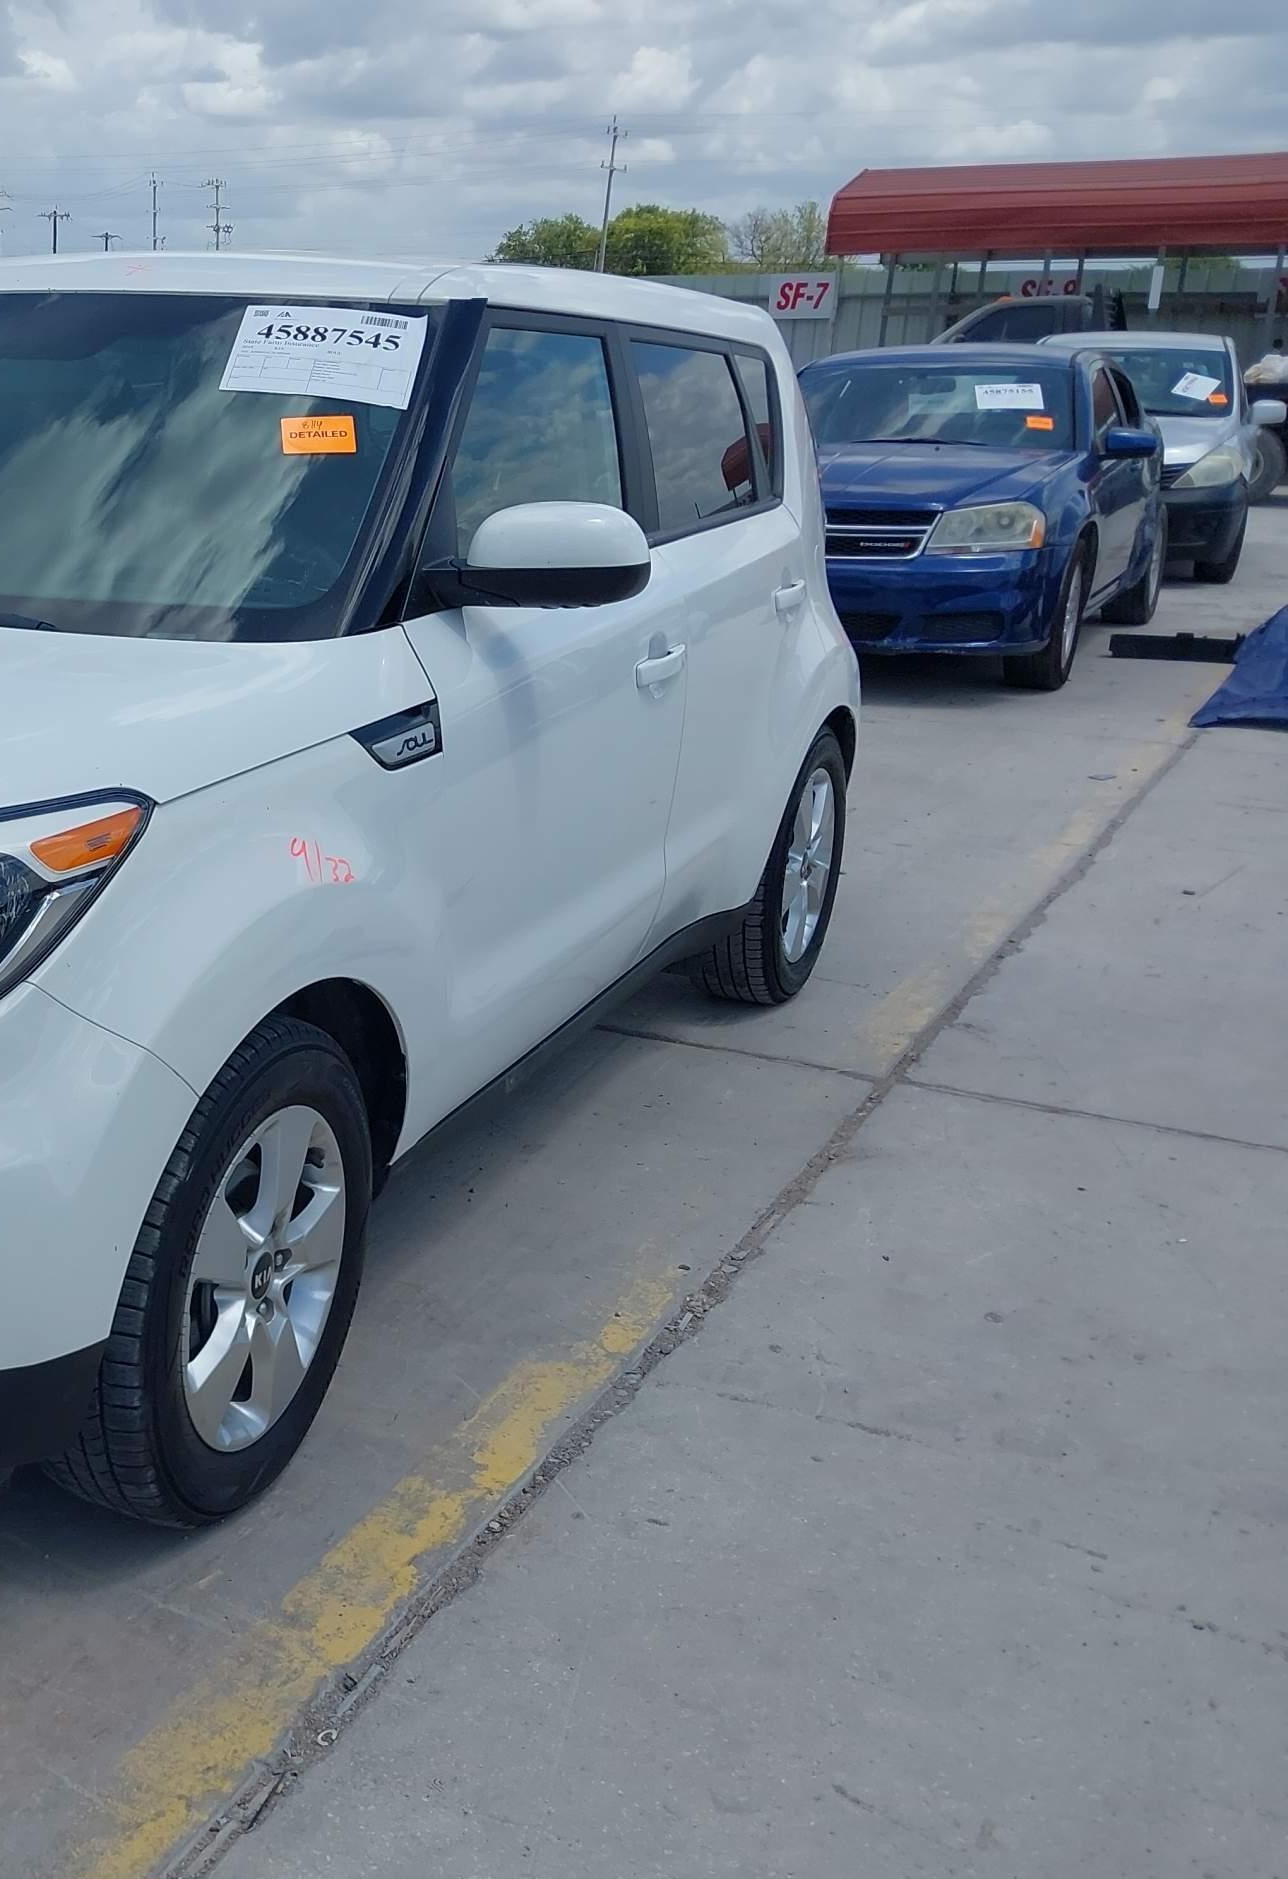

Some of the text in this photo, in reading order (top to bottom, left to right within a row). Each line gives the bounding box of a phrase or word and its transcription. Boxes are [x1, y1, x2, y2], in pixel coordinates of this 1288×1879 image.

[776, 282, 830, 310] SF-7
[257, 323, 402, 351] 45887545
[289, 430, 348, 439] DETAILED
[290, 837, 354, 883] 9/32
